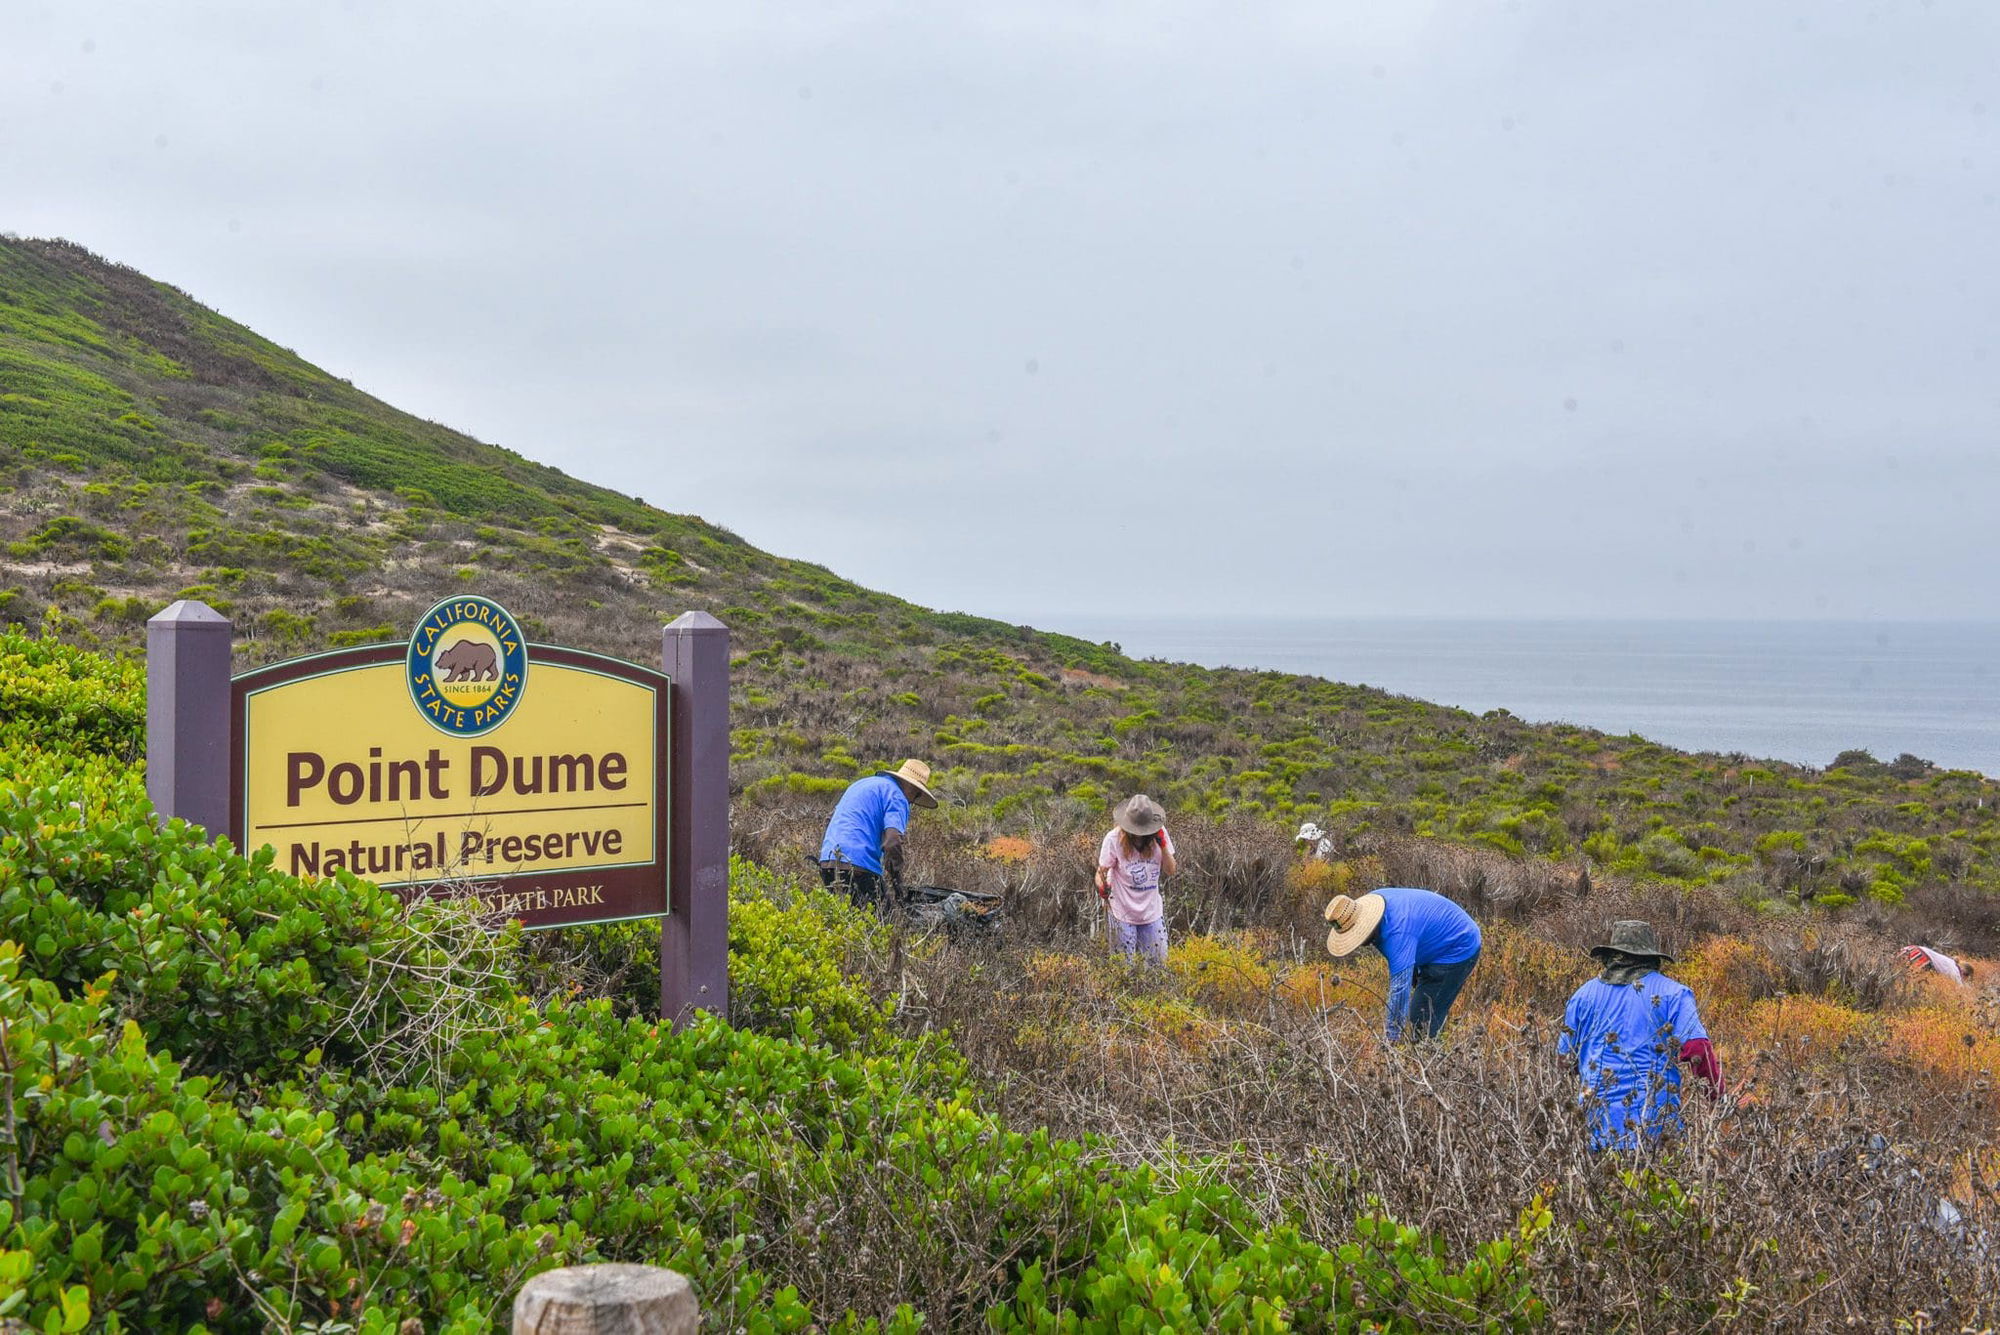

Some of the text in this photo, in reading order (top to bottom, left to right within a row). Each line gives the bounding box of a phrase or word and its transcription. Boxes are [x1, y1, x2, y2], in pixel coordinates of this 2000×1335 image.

[416, 602, 519, 657] CALIFORNIA
[415, 673, 520, 728] STATE PARKS
[444, 685, 491, 694] SINCE 1864
[287, 745, 628, 807] Point Dume
[291, 828, 622, 879] Natural Preserve
[486, 890, 546, 914] STATE
[553, 885, 605, 908] PARK
